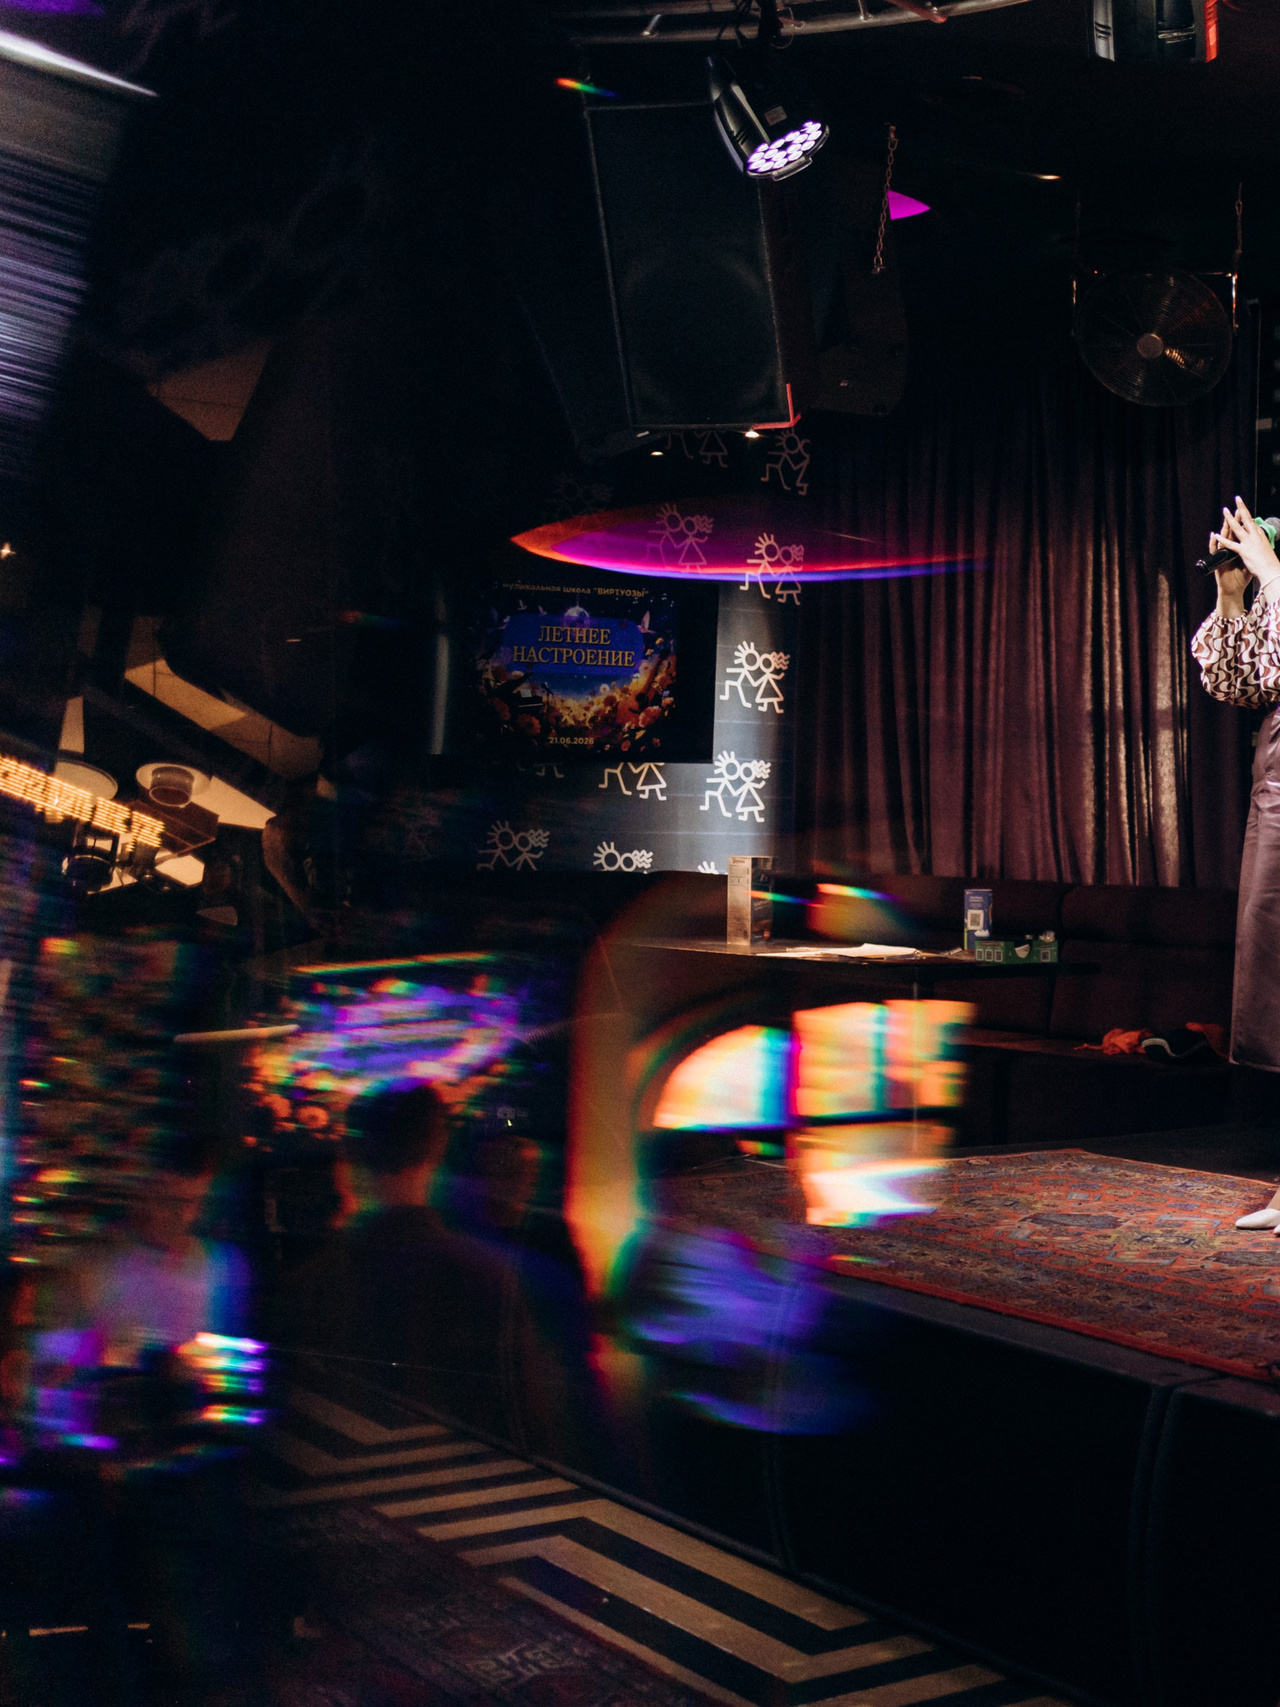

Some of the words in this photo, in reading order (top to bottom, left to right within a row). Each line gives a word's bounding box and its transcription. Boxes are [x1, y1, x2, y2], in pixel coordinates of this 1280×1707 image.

[563, 586, 591, 594] школа
[593, 587, 649, 598] "ВИРТУОЗЫ"
[538, 625, 611, 645] ЛЕТНЕЕ
[512, 646, 636, 668] НАСТРОЕНИЕ
[549, 736, 595, 745] 21.06.2026
